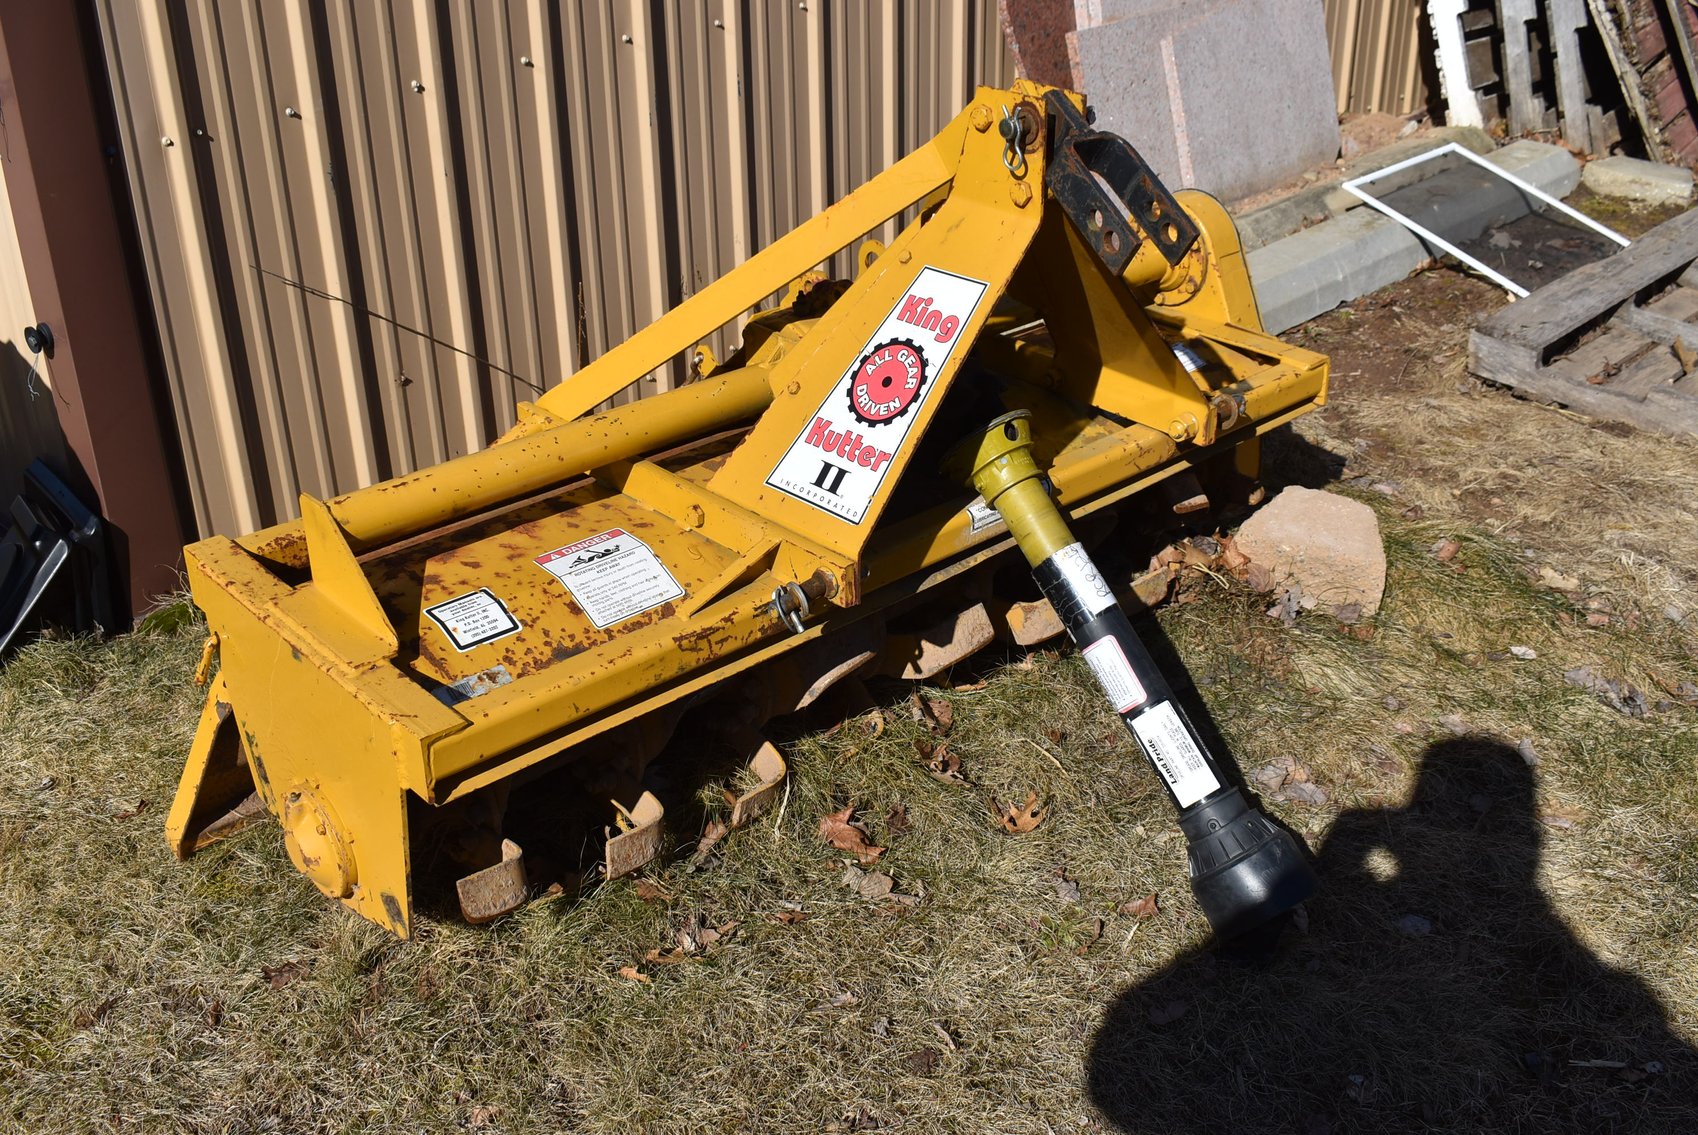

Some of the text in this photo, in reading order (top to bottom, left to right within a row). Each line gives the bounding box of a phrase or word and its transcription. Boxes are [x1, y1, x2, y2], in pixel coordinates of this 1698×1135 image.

[897, 295, 960, 343] King
[865, 349, 919, 390] ALL GEAR
[856, 383, 901, 416] DRIVEN
[804, 417, 892, 472] Kutter
[810, 460, 852, 497] II
[780, 478, 858, 518] INCORPORATED
[562, 534, 611, 555] DANGER
[609, 562, 621, 570] AWAY
[1148, 739, 1164, 762] Pride
[1161, 763, 1178, 784] Land
